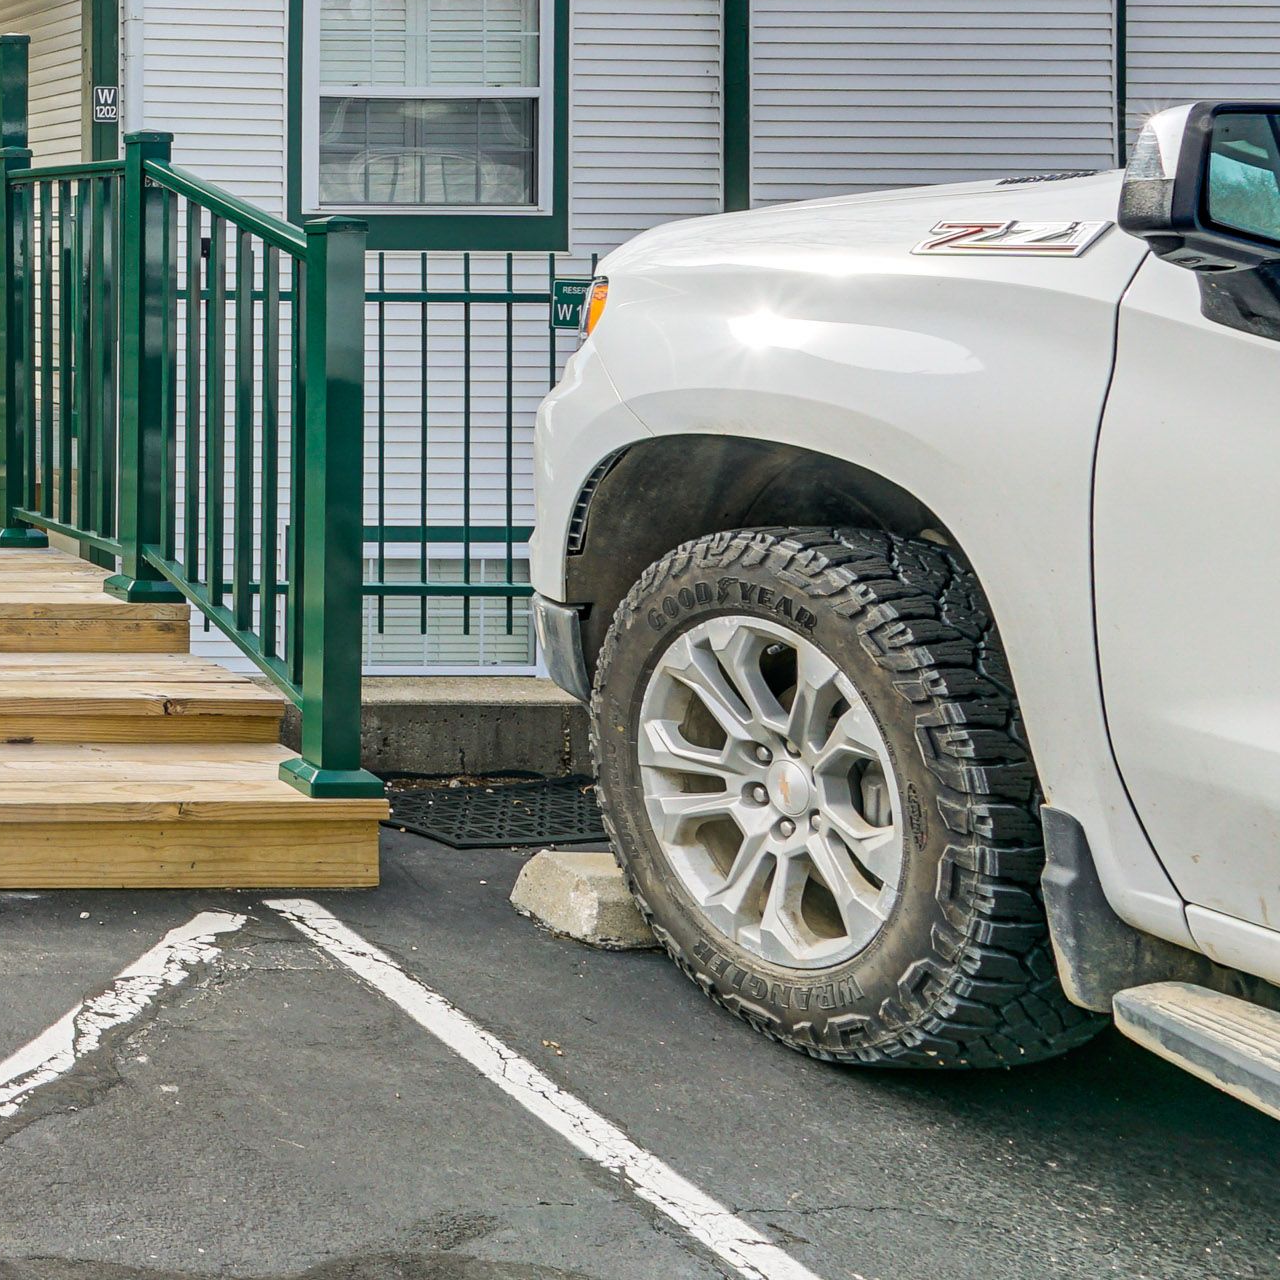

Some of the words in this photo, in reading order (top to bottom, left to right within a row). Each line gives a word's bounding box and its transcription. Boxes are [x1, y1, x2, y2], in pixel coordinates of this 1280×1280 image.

[97, 88, 115, 104] W
[95, 105, 117, 118] 1202
[910, 220, 1115, 257] Z71
[562, 286, 587, 294] RESER
[557, 303, 573, 321] W
[648, 577, 818, 634] GOODYEAR
[693, 937, 865, 1011] WRANGLER
